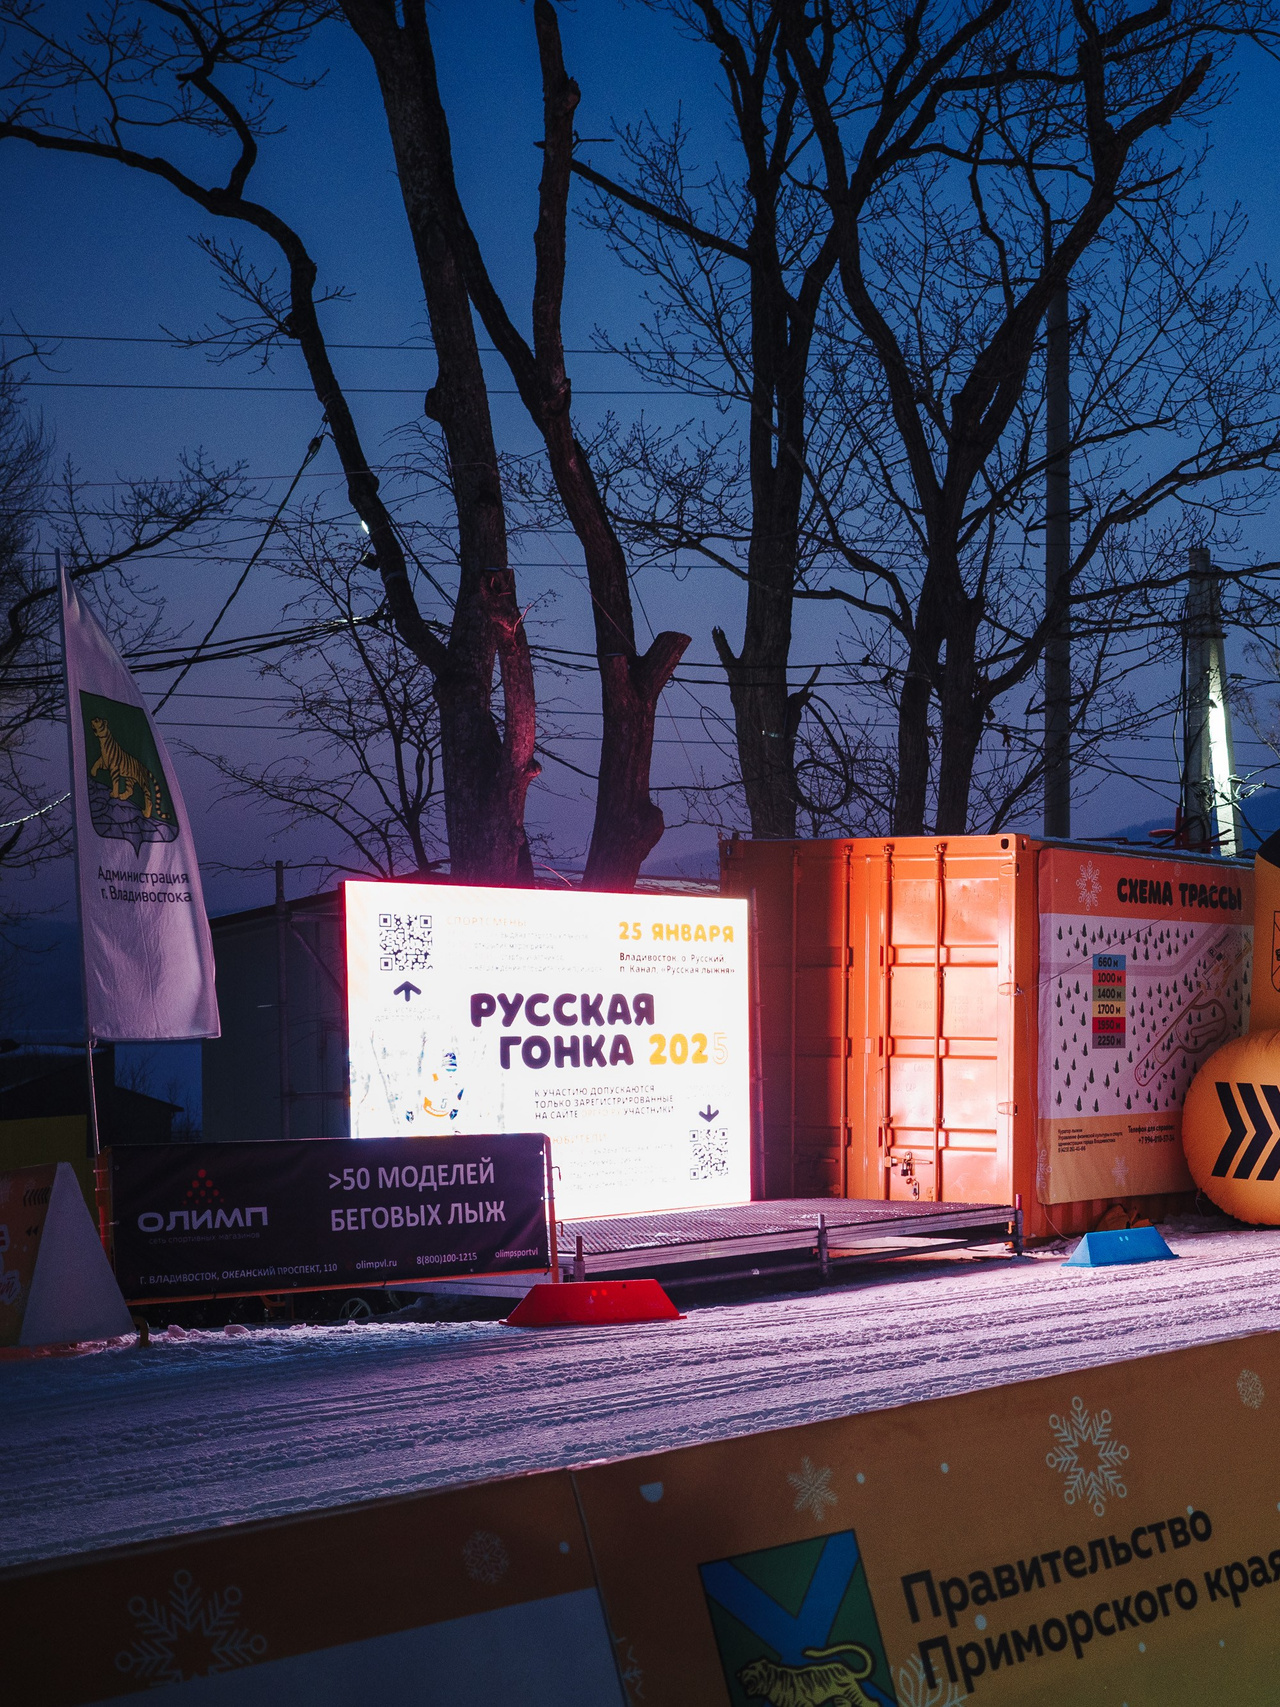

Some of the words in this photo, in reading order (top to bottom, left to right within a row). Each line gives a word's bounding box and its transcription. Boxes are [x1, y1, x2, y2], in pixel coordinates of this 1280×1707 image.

[97, 865, 189, 887] Администрация
[101, 888, 108, 900] г.
[111, 885, 193, 903] Владивостока
[1117, 877, 1173, 906] СХЕМА
[1179, 882, 1242, 911] ТРАССЫ
[618, 921, 643, 941] 25
[651, 922, 735, 944] ЯНВАРЯ
[1098, 956, 1112, 967] 660
[1098, 973, 1116, 983] 1000
[1098, 988, 1116, 998] 1400
[470, 992, 655, 1028] РУССКАЯ
[1098, 1004, 1115, 1014] 1700
[1098, 1035, 1115, 1046] 2250
[499, 1034, 635, 1070] ГОНКА
[649, 1031, 729, 1066] 2025
[534, 1089, 540, 1098] К
[543, 1087, 588, 1097] УЧАСТИЮ
[590, 1084, 655, 1097] ДОПУСКАЮТСЯ
[534, 1099, 571, 1109] ТОЛЬКО
[574, 1094, 674, 1108] ЗАРЕГИСТРИРОВАННЫЕ
[535, 1111, 548, 1120] НА
[550, 1109, 578, 1119] САЙТЕ
[623, 1105, 674, 1116] УЧАСТНИКИ
[552, 1133, 608, 1145] ЮБИТЕЛИ
[328, 1167, 370, 1191] >50
[378, 1156, 495, 1192] МОДЕЛЕЙ
[137, 1206, 269, 1233] ОЛИМП
[331, 1203, 443, 1232] БЕГОВЫХ
[447, 1200, 507, 1225] ЛЫЖ
[149, 1237, 167, 1245] сеть
[168, 1235, 216, 1244] спортивных
[218, 1232, 260, 1241] магазинов
[416, 1252, 478, 1266] 8(800)100-1215
[494, 1247, 539, 1260] olimpsportvl
[355, 1258, 398, 1270] olimpvl.ru
[139, 1276, 147, 1285] Г.
[149, 1271, 220, 1285] ВЛАДИВОСТОК,
[221, 1265, 276, 1279] ОКЕАНСКИЙ
[278, 1263, 322, 1277] ПРОСПЕКТ,
[324, 1263, 338, 1273] 110
[901, 1508, 1214, 1629] Правительство
[917, 1573, 1199, 1690] Приморского
